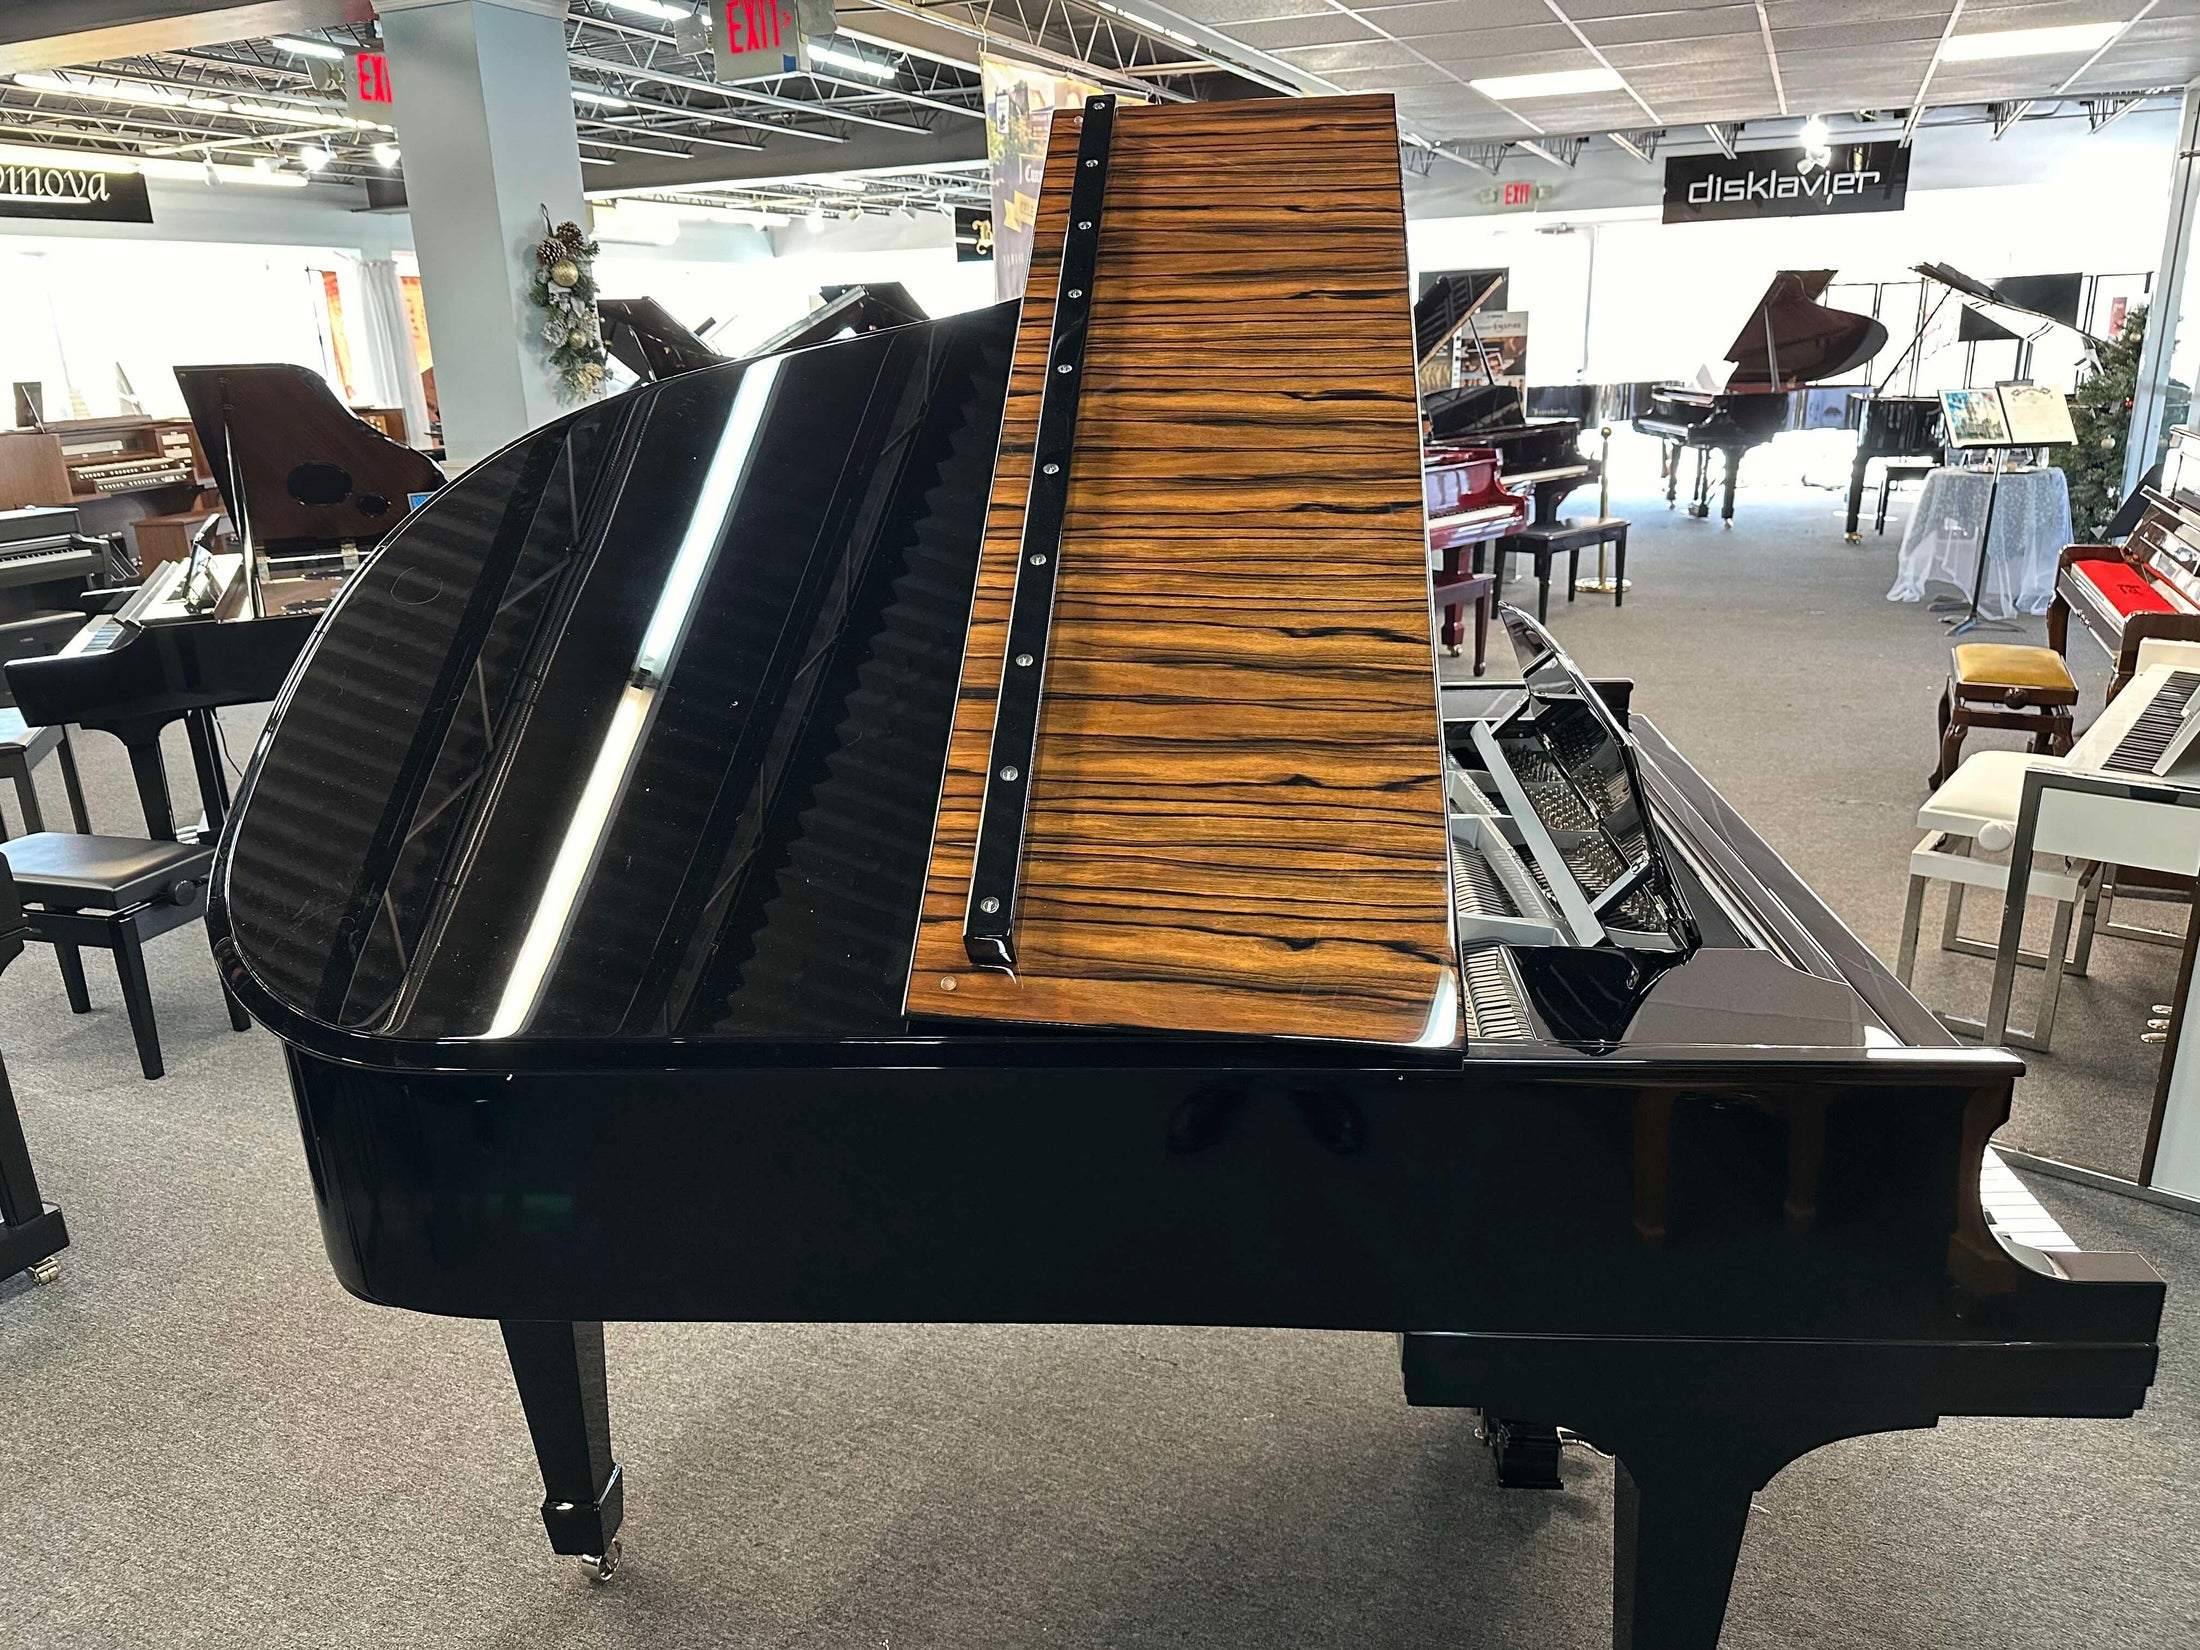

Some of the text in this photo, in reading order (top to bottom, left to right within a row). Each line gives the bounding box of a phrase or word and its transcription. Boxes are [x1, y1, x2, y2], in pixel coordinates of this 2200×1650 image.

[726, 0, 780, 54] EXIT
[0, 165, 110, 201] inova
[1504, 183, 1531, 205] EXIT
[1688, 170, 1880, 203] disklavier
